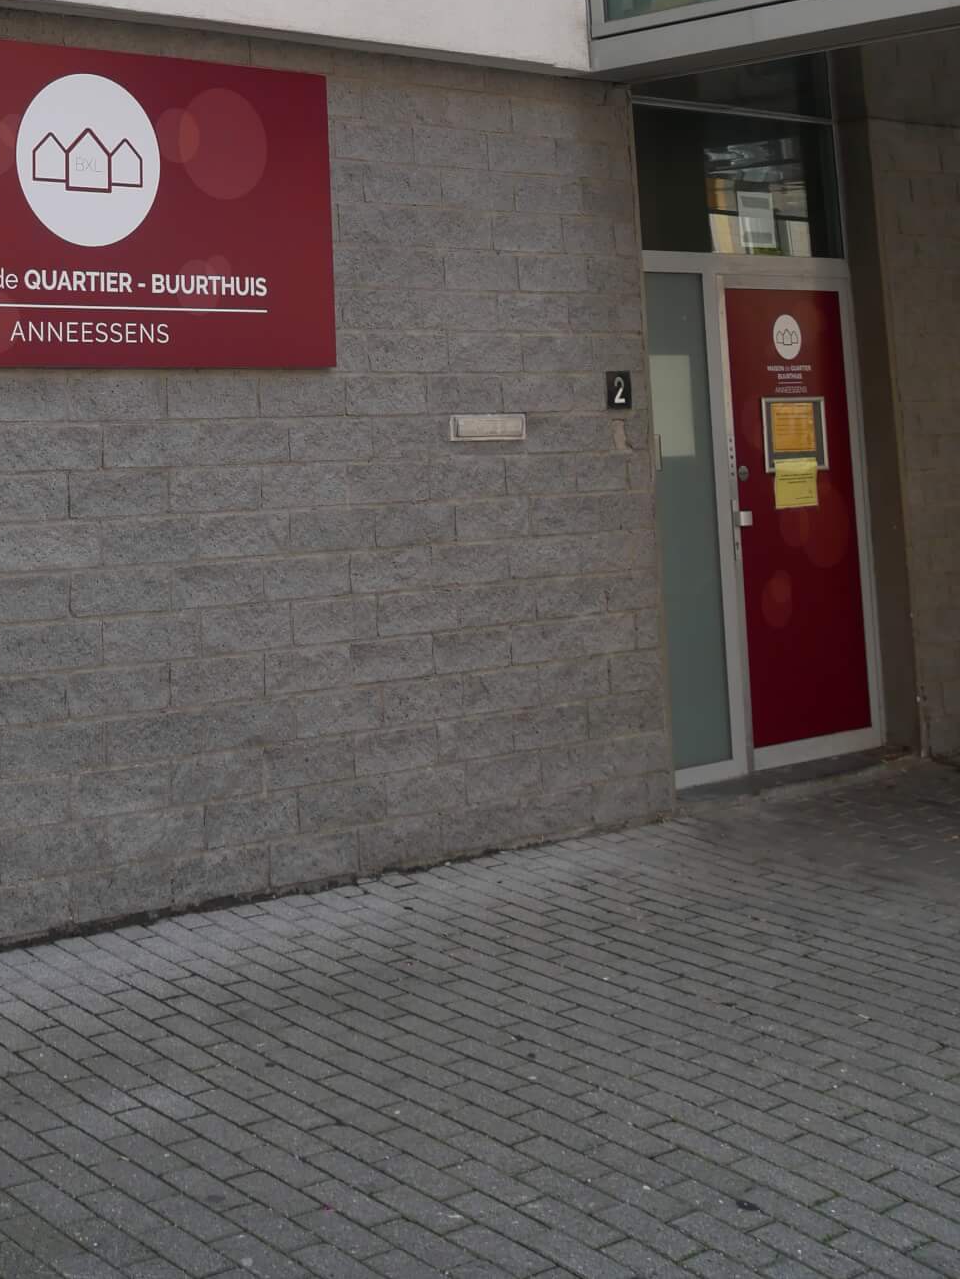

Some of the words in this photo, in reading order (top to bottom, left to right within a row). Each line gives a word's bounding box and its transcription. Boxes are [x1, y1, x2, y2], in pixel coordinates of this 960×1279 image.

[75, 156, 104, 173] BXL
[23, 269, 132, 293] QUARTIER
[151, 274, 268, 297] BUURTHUIS
[10, 321, 170, 344] ANNEESSENS
[614, 377, 626, 404] 2
